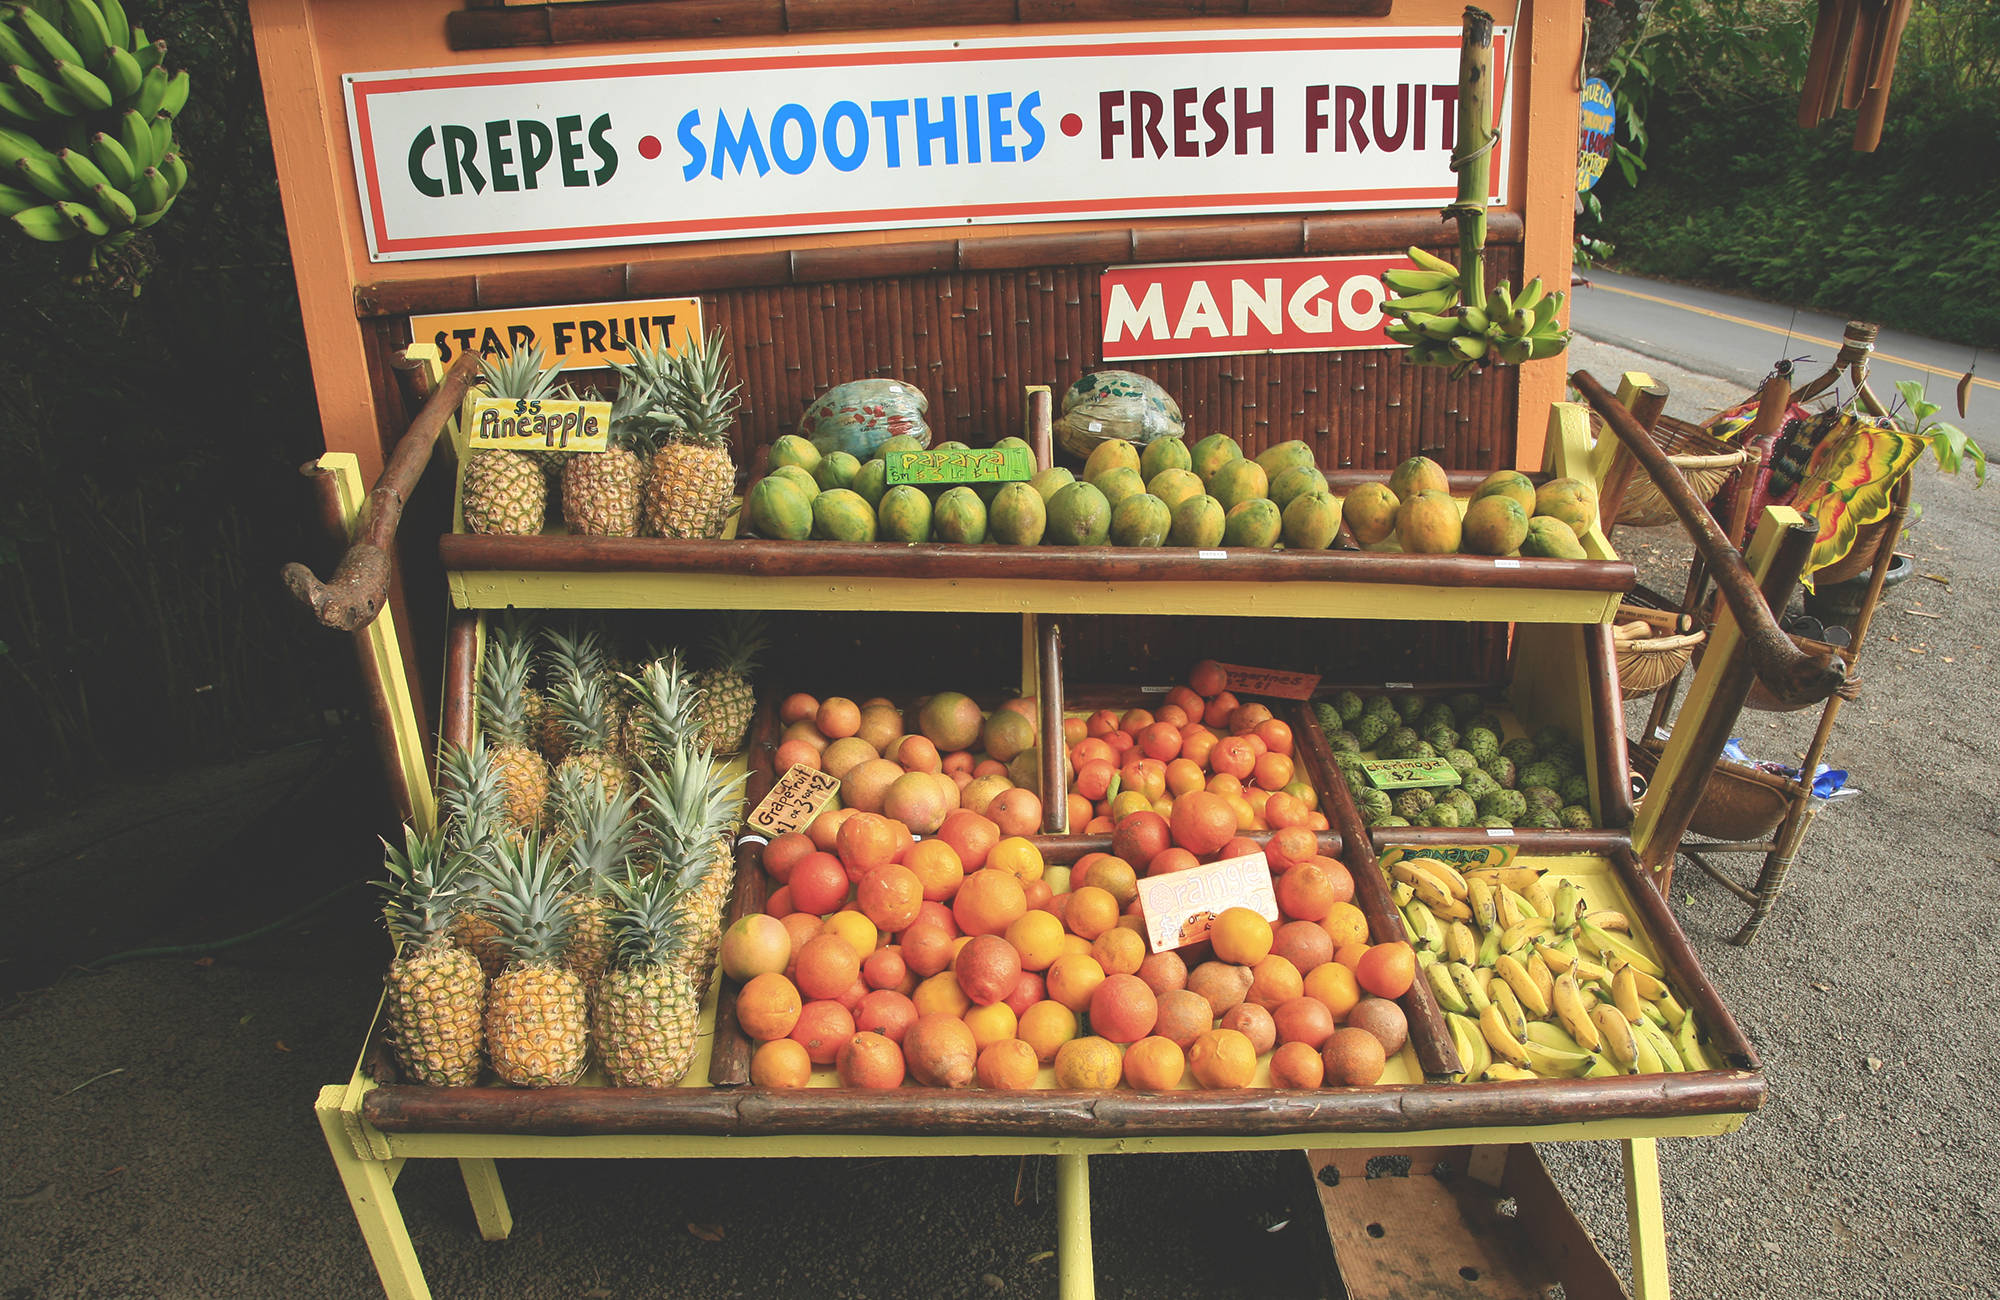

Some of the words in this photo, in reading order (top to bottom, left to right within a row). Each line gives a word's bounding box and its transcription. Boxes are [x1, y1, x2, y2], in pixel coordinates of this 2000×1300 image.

[1582, 83, 1612, 109] HUELO
[407, 112, 619, 198] CREPES
[676, 90, 1046, 182] SMOOTHIES
[1099, 85, 1274, 160] FRESH
[1305, 83, 1459, 154] FRUIT
[552, 315, 675, 355] FRUIT
[479, 406, 600, 448] Pineapple
[514, 399, 541, 416] $5
[915, 467, 945, 481] $3
[972, 467, 1001, 481] $4
[1391, 769, 1421, 781] $2
[758, 767, 812, 826] Grapefruit
[774, 821, 797, 834] $1
[793, 799, 814, 814] 3
[809, 774, 836, 792] $2
[1148, 861, 1258, 914] Orange
